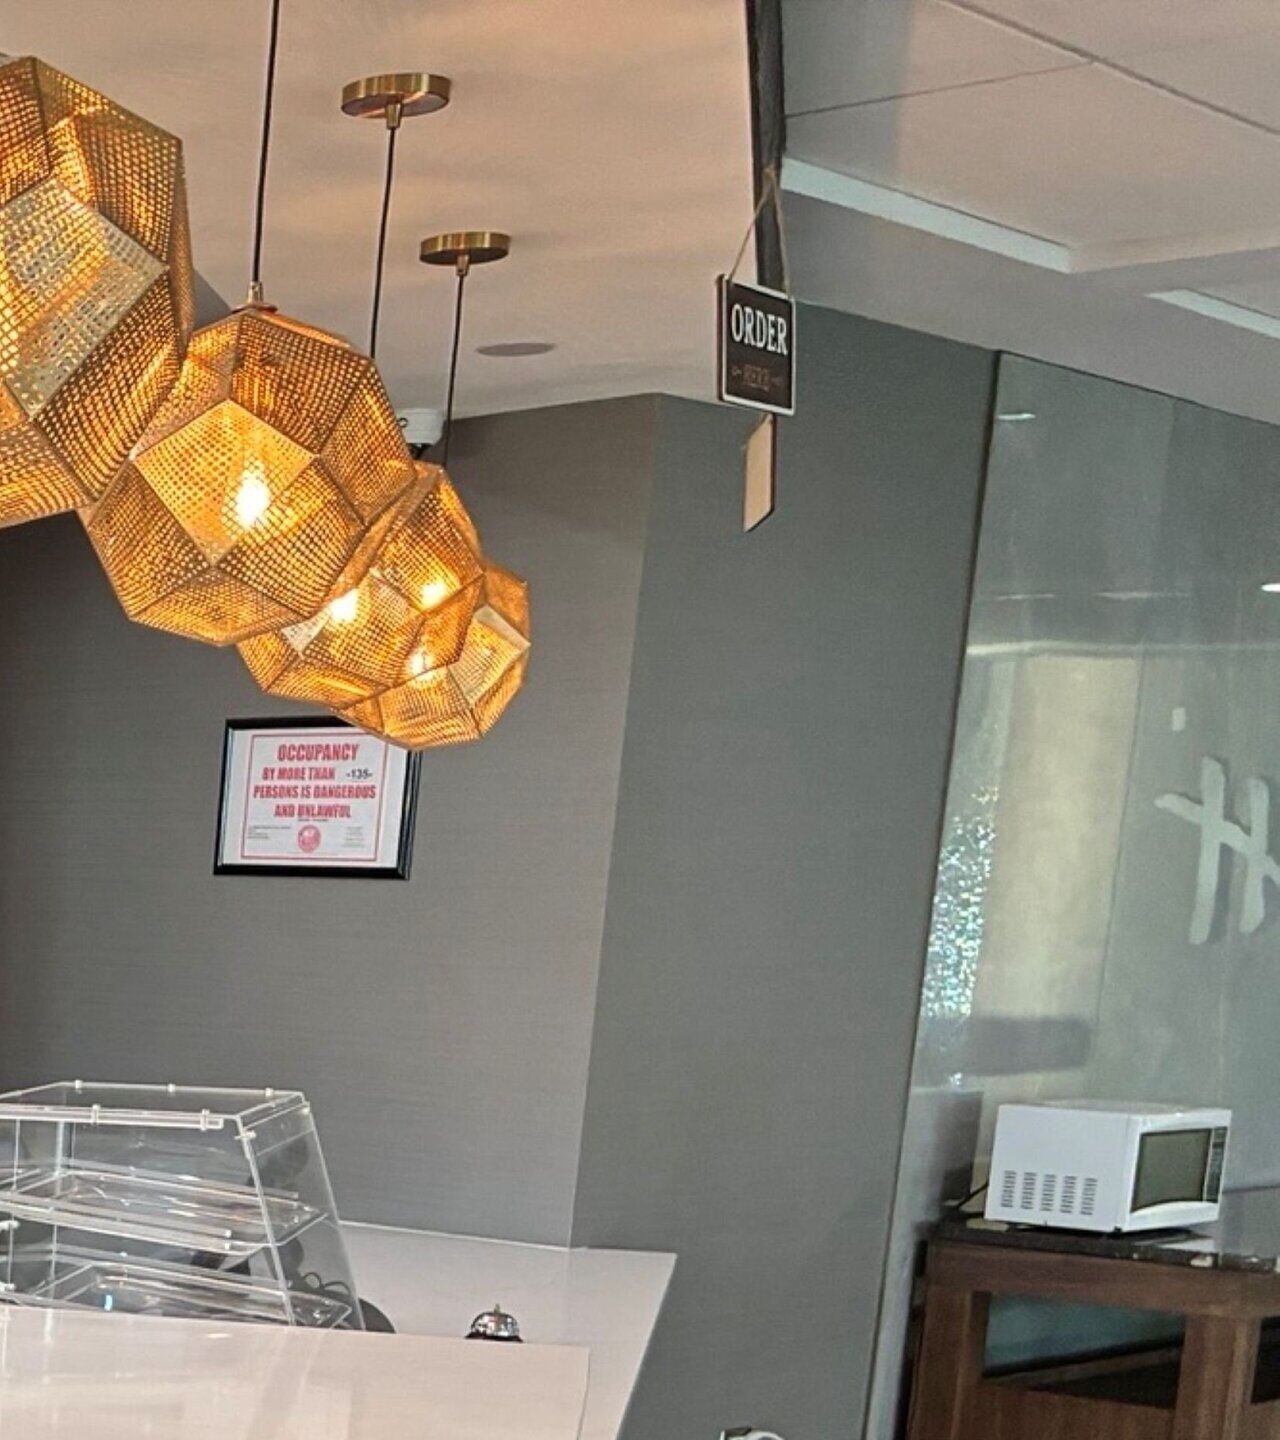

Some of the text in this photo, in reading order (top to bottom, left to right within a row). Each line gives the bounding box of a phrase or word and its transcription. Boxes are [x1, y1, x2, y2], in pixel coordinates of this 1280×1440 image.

[731, 303, 788, 355] ORDER
[277, 743, 359, 761] OCCUPANCY
[262, 766, 275, 781] BY
[277, 766, 306, 781] MORE
[309, 767, 336, 781] THAN
[253, 785, 376, 799] PERSONS IS DANGEROUS
[274, 804, 351, 818] AND UNLAWFUL
